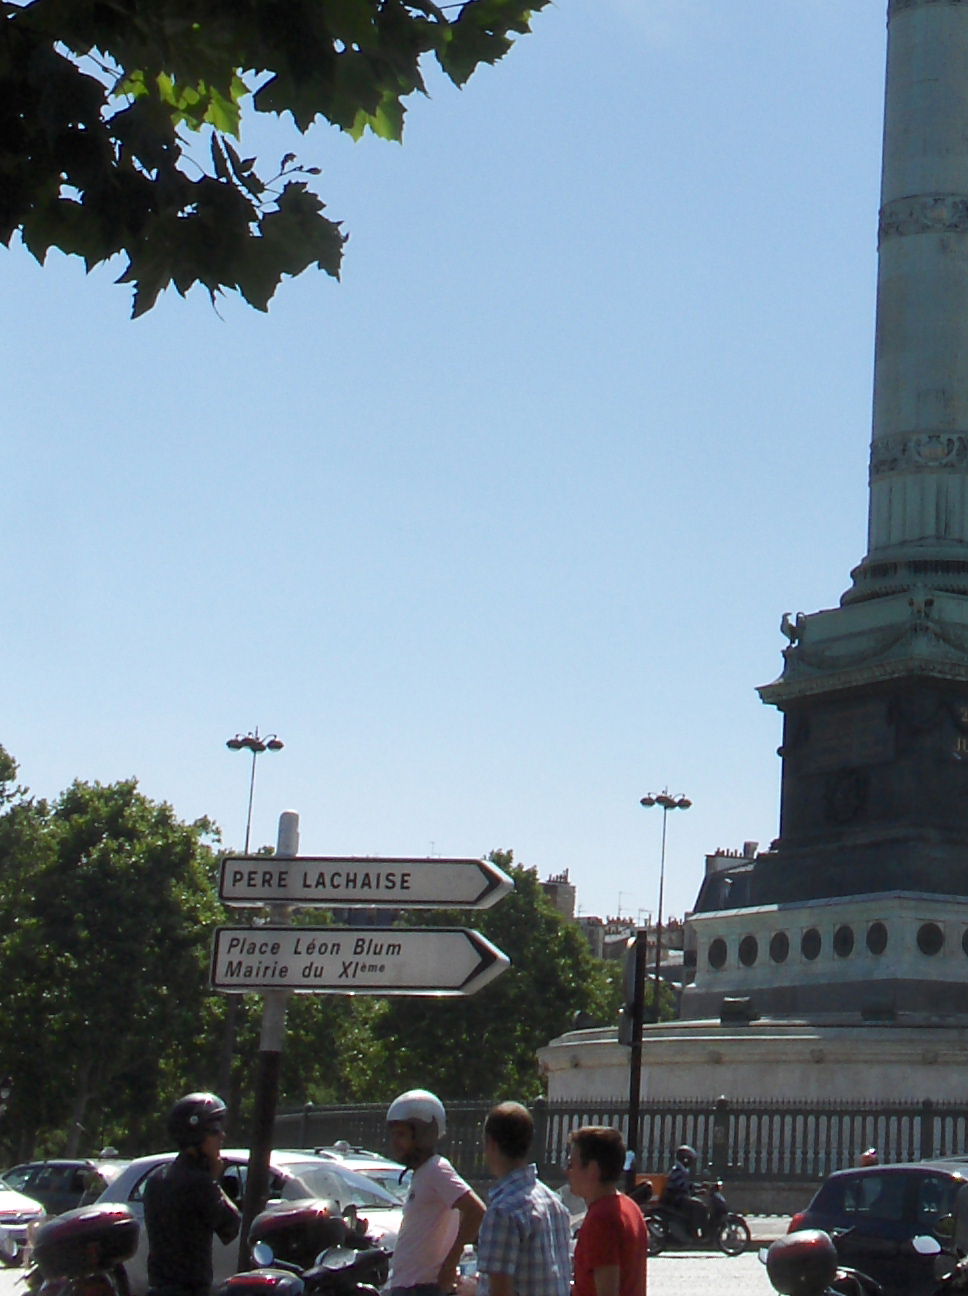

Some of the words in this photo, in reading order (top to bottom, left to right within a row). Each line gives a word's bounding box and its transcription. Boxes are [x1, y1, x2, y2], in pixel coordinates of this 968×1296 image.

[232, 870, 288, 888] PERE
[302, 872, 411, 890] LACHAISE
[227, 937, 281, 955] Place
[294, 938, 341, 955] Léon
[353, 938, 402, 956] Blum
[224, 961, 289, 978] Mairie
[302, 961, 324, 978] du
[338, 961, 386, 979] XIème
